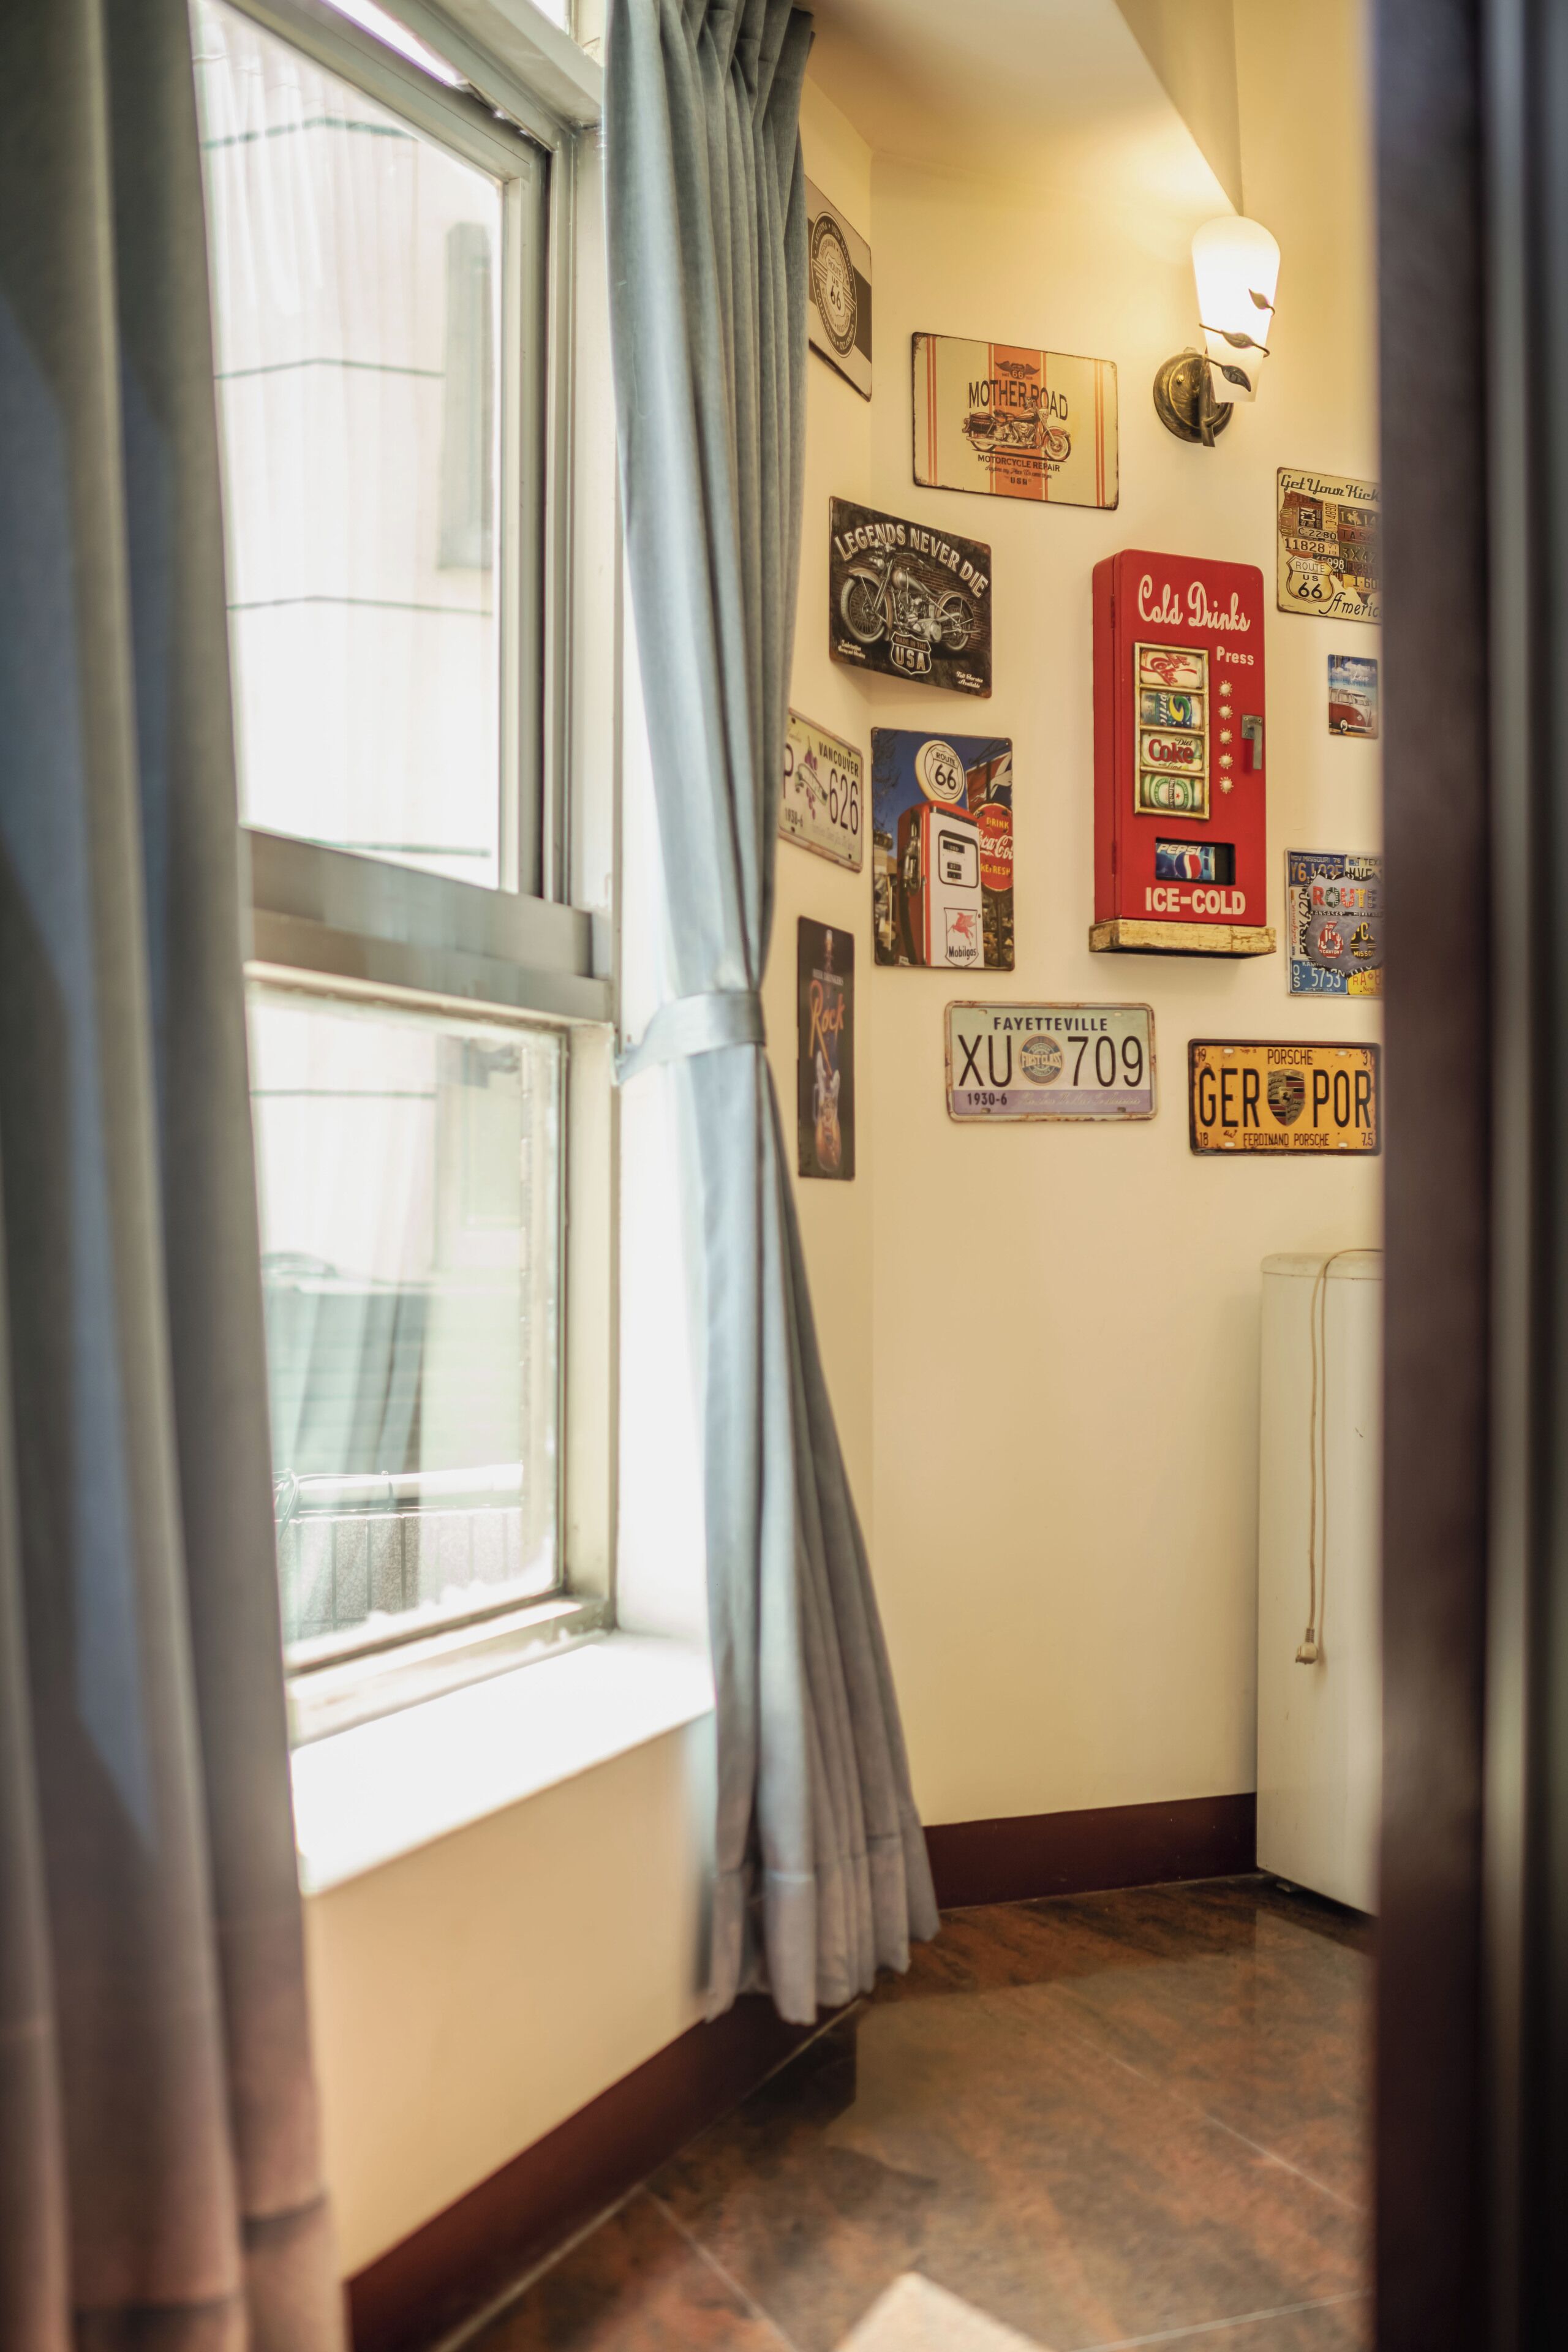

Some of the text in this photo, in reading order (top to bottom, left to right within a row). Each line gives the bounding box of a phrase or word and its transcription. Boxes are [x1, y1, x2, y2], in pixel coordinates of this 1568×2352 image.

[828, 258, 842, 276] ROUTE
[831, 285, 842, 311] 66
[1012, 370, 1023, 379] 66
[969, 380, 1068, 421] MOTHER ROAD
[978, 454, 1031, 469] MOTORCYCLE
[1281, 474, 1381, 502] Get Your Kick
[1285, 538, 1325, 553] 11828
[834, 524, 989, 598] LEGENDS NEVER DIE
[1295, 561, 1325, 573] ROUTE
[1298, 582, 1323, 599] 66
[1138, 575, 1251, 631] Cold Drinks
[1319, 592, 1383, 618] Americ
[895, 636, 910, 646] MADE
[917, 641, 927, 650] THE
[896, 646, 926, 671] USA
[1216, 646, 1254, 666] Press
[1148, 738, 1194, 764] Coke
[1175, 737, 1193, 746] Diet
[818, 741, 859, 777] VANCOUVER
[935, 752, 957, 766] ROUTE
[935, 764, 957, 791] 66
[829, 768, 858, 835] 626
[987, 816, 1009, 829] DRINK
[1157, 843, 1202, 856] PEPSI
[1145, 888, 1246, 914] ICE-COLD
[1313, 886, 1378, 908] ROUTE
[949, 945, 976, 960] Mobilgas
[809, 980, 845, 1076] Rock
[993, 1017, 1108, 1031] FAYETTEVILLE
[957, 1035, 1144, 1088] XU 709
[1022, 1052, 1061, 1068] FIRST CLASS
[1267, 1049, 1313, 1065] PORSCHE
[967, 1092, 1008, 1106] 1930-6
[1199, 1068, 1371, 1128] GER POR
[1243, 1133, 1289, 1147] FERDINAND
[1294, 1133, 1330, 1147] PORSCHE
